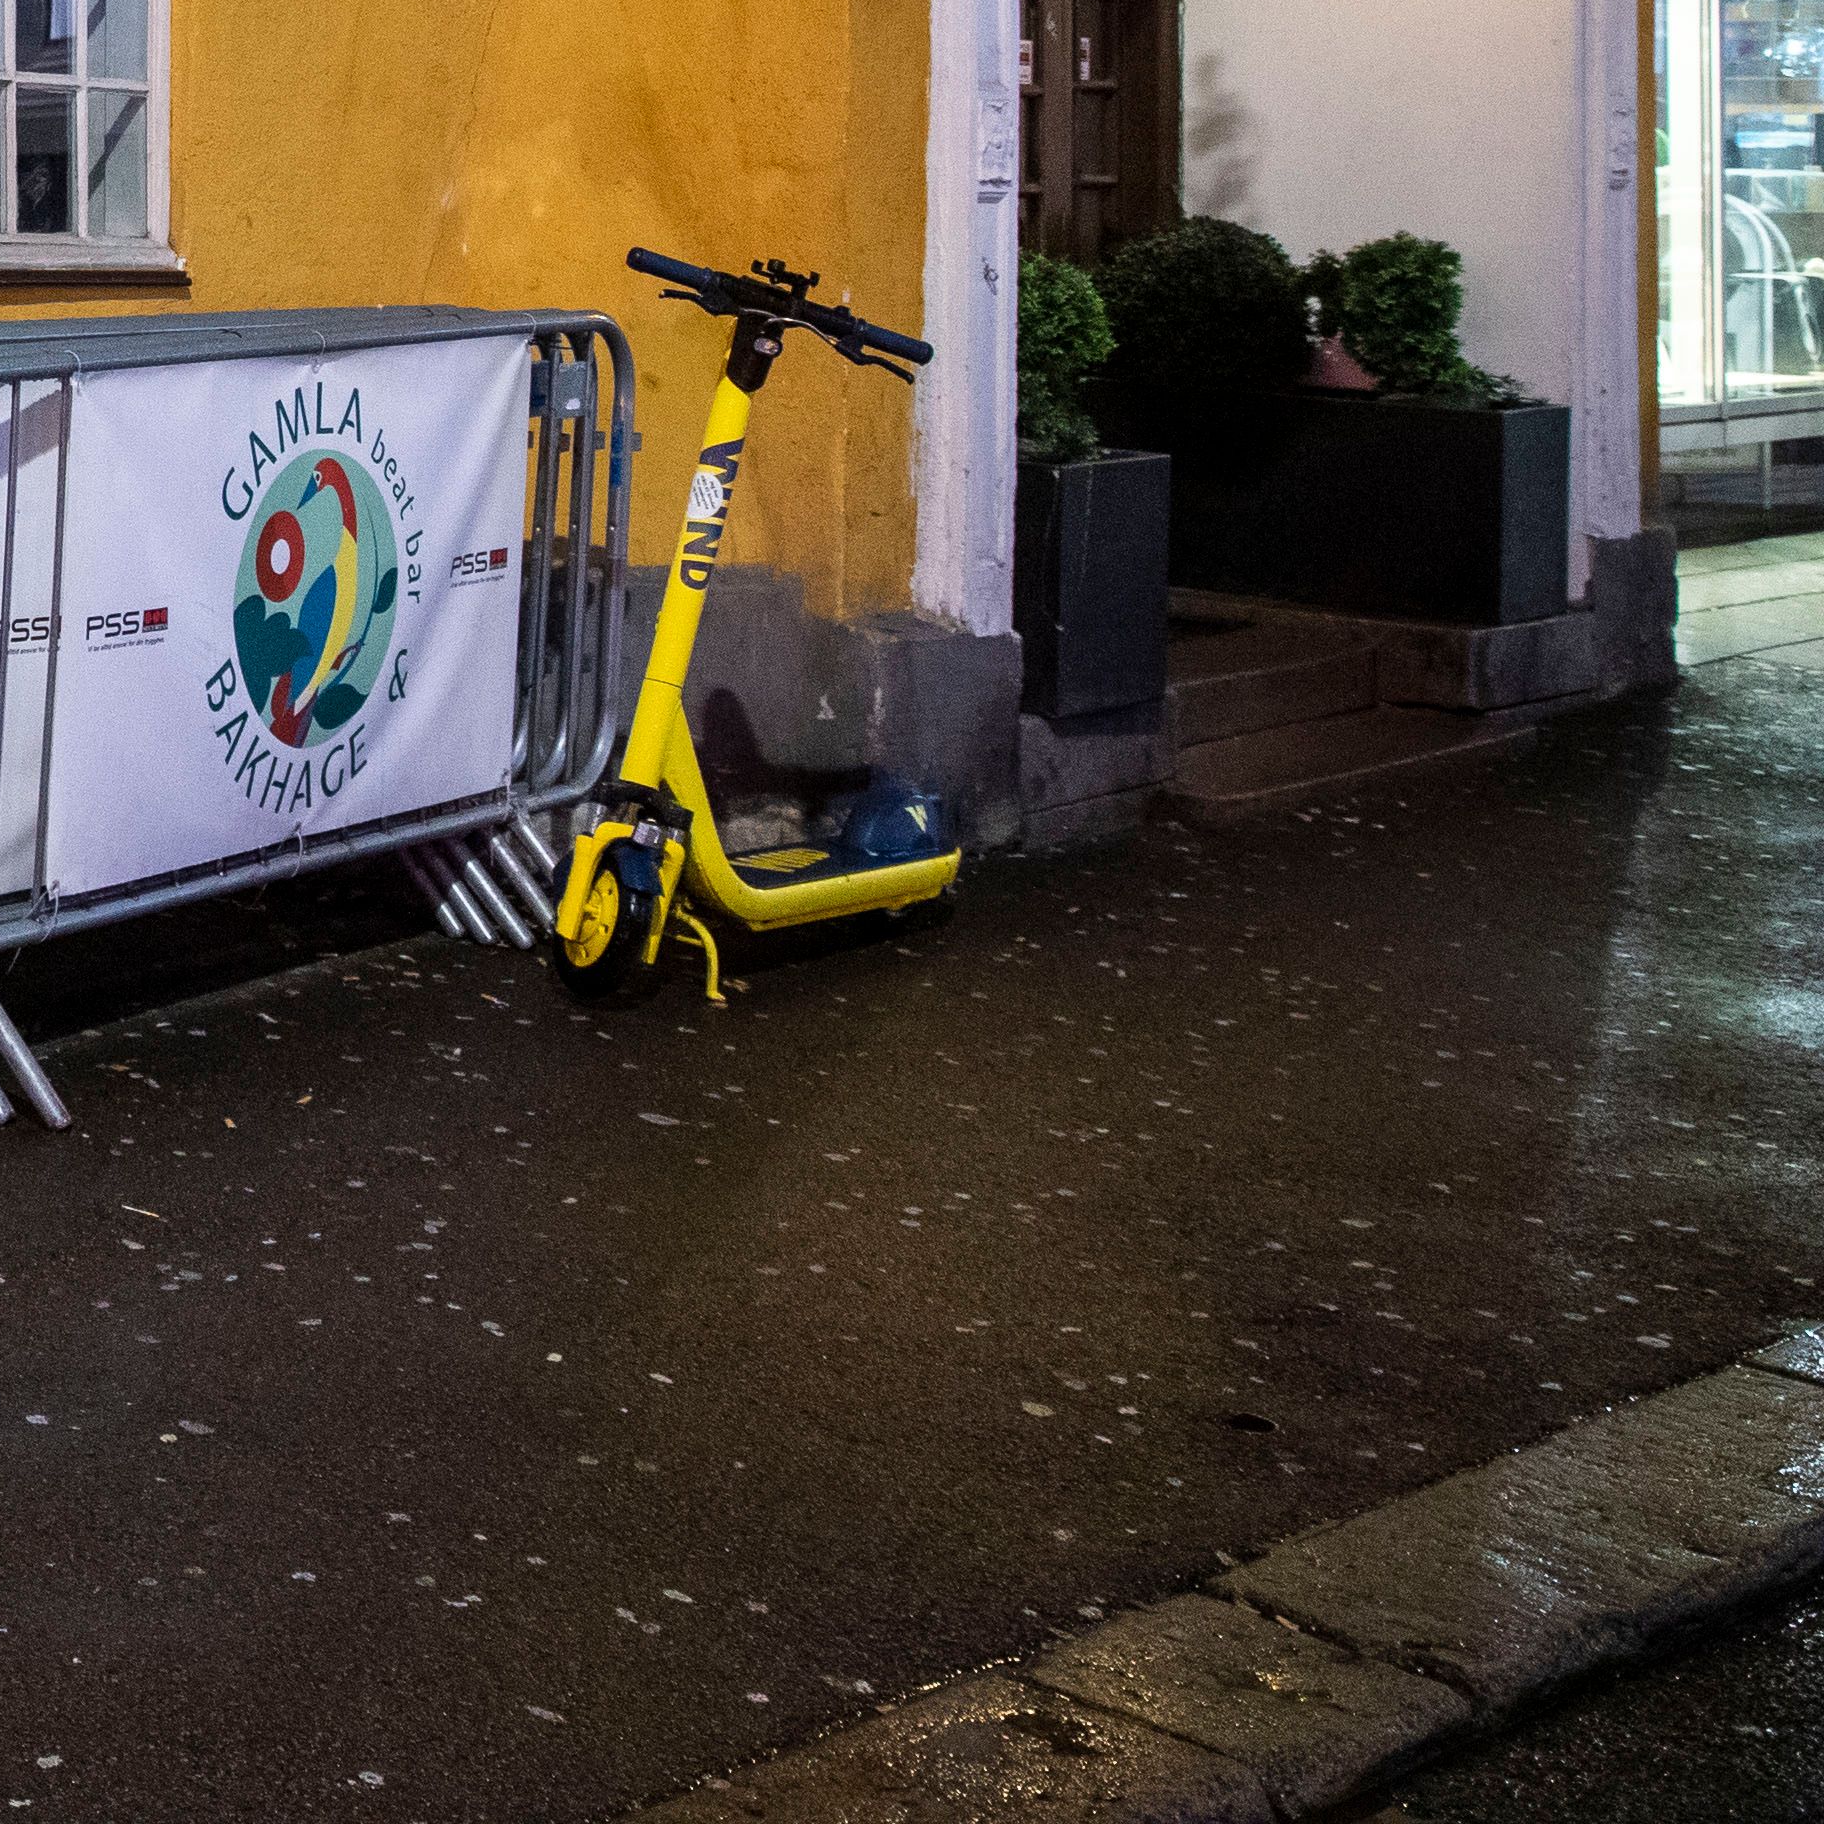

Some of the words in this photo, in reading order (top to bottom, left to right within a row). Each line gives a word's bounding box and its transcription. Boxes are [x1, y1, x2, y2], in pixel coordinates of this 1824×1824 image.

[221, 381, 363, 523] GAMLA
[369, 428, 415, 520] beat
[405, 528, 422, 606] bar
[450, 551, 487, 578] PSS
[86, 610, 140, 641] PSS
[388, 647, 407, 703] &
[205, 656, 368, 815] BAKHAGE
